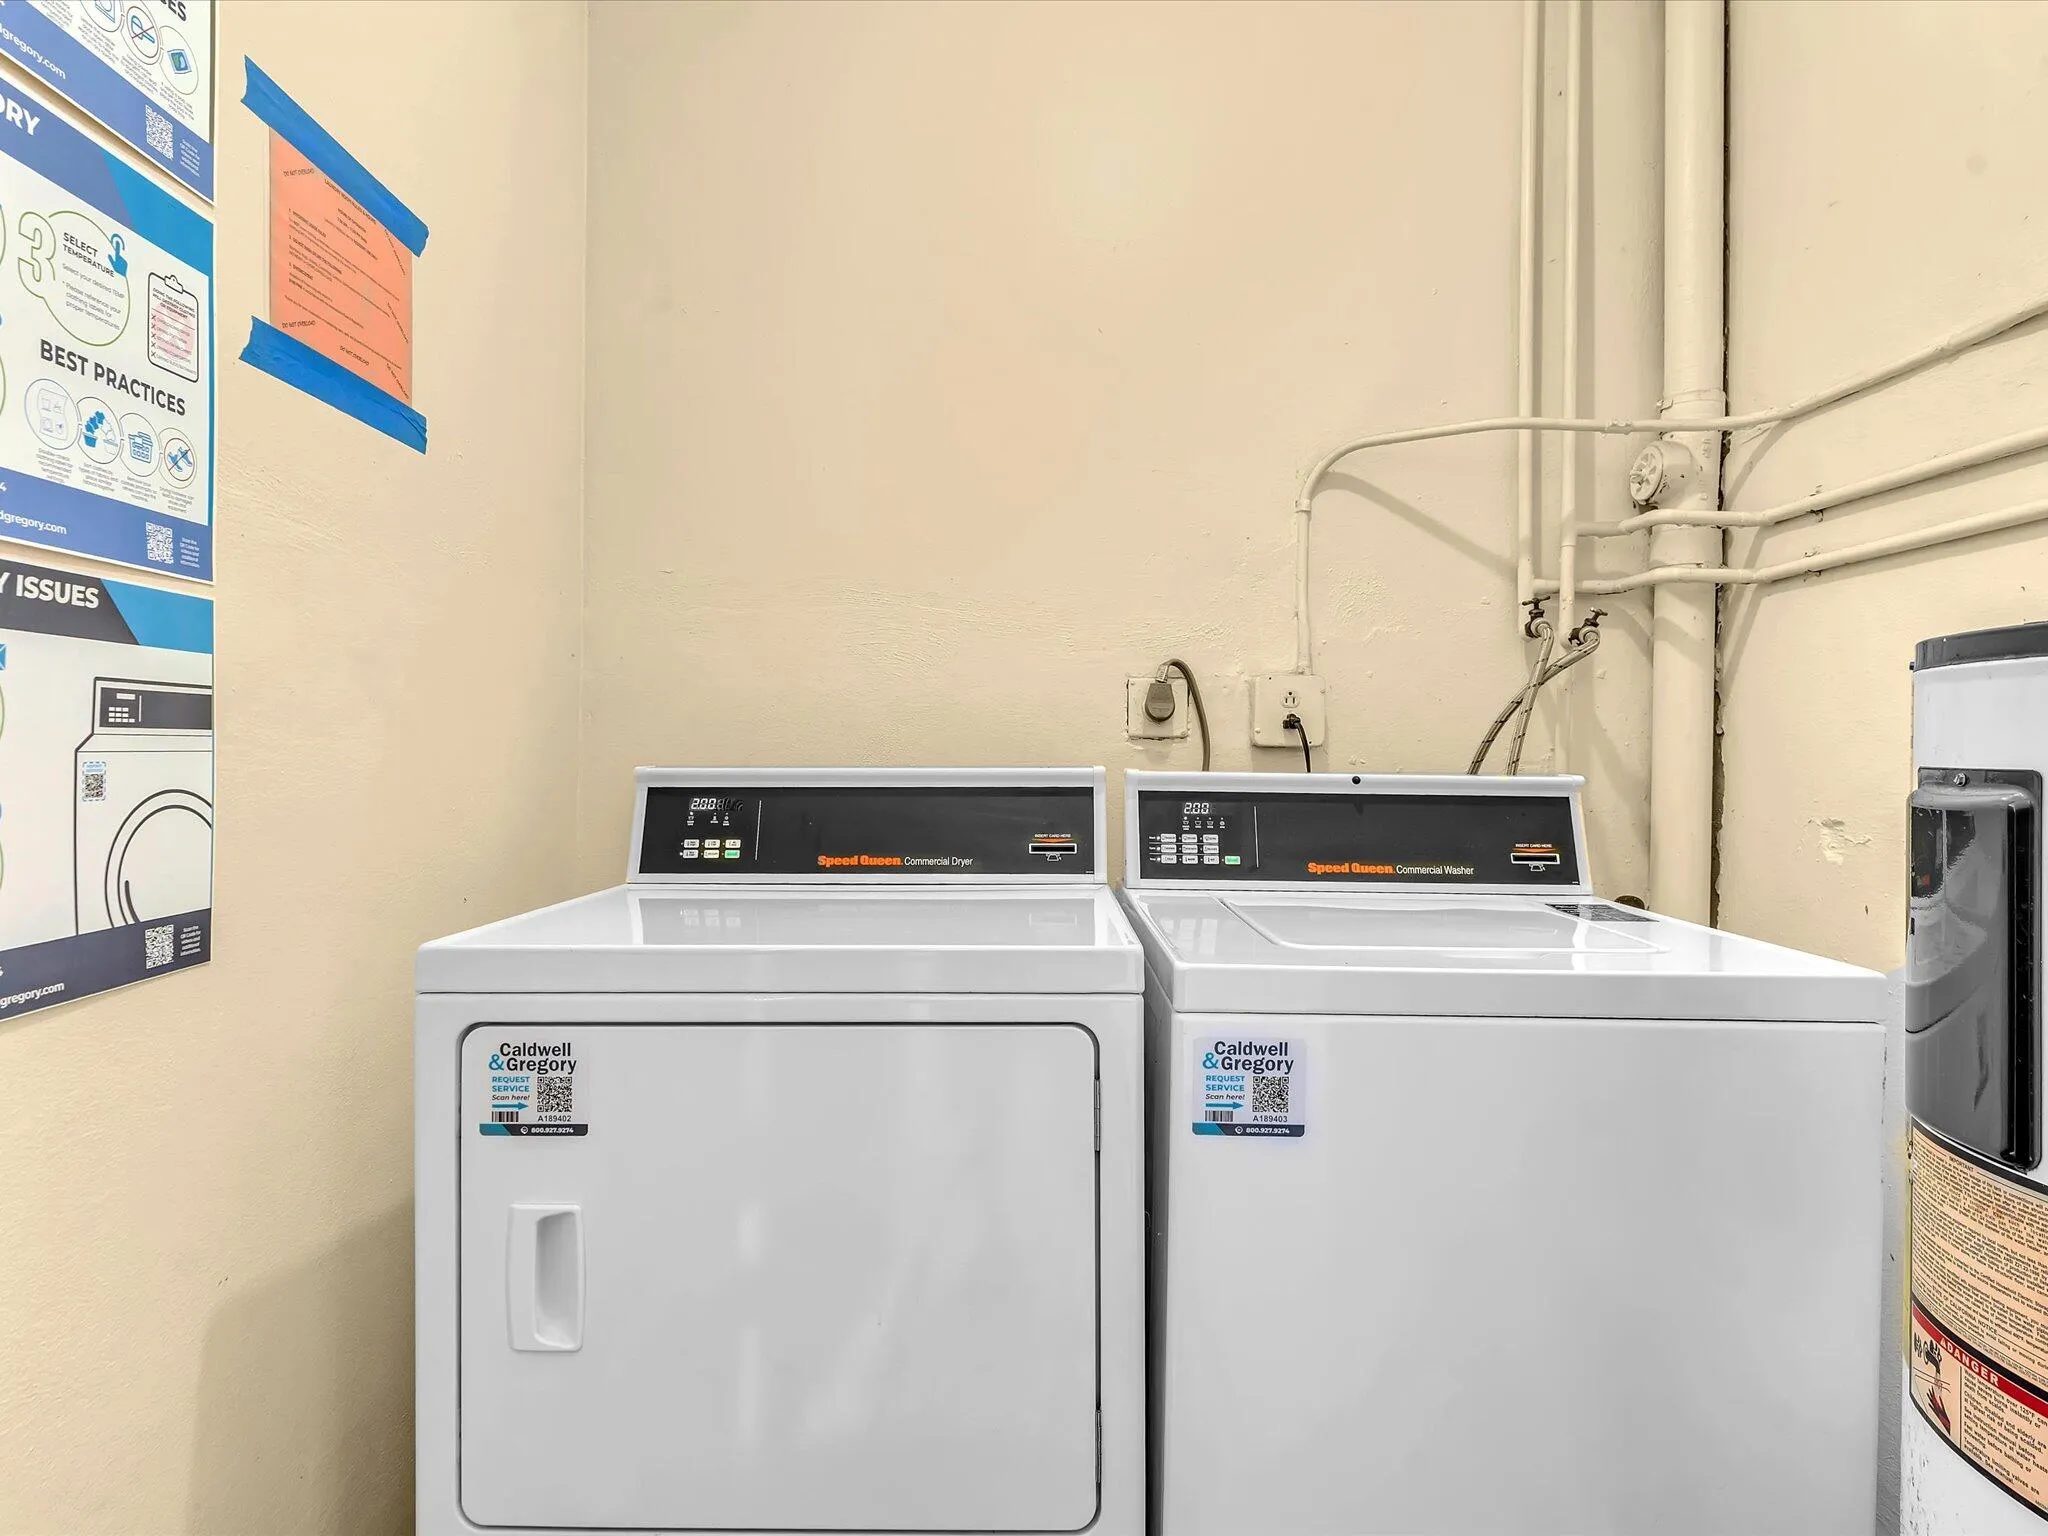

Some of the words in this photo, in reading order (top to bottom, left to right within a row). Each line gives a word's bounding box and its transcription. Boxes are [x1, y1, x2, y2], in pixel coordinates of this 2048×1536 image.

[161, 0, 186, 21] ES
[63, 231, 98, 257] SELECT
[63, 243, 115, 278] TEMPERATURE
[40, 338, 88, 376] BEST
[94, 362, 186, 417] PRACTICES
[16, 574, 99, 609] ISSUES
[1184, 802, 1210, 814] 2.00
[817, 855, 859, 868] Speed
[904, 856, 950, 866] Commercial
[952, 856, 974, 868] Dryer
[1308, 862, 1350, 875] Speed
[1396, 864, 1442, 875] Commercial
[1444, 865, 1474, 876] Washer
[488, 1054, 504, 1071] &
[506, 1058, 577, 1075] Gregory
[500, 1042, 571, 1056] Caldwell
[1202, 1052, 1219, 1069] &
[1221, 1056, 1294, 1075] Gregory
[1214, 1041, 1288, 1056] Caldwell
[1949, 1155, 1973, 1172] IMPORTANT
[1949, 1299, 1976, 1322] CALIFORNIA
[1977, 1319, 1997, 1335] NOTICE
[1947, 1343, 2000, 1387] DANGER
[1964, 1367, 1975, 1380] Water
[1977, 1377, 2004, 1401] temperature
[2006, 1398, 2017, 1408] over
[2037, 1416, 2047, 1426] can
[1964, 1380, 1975, 1393] death
[1976, 1390, 1987, 1401] from
[1988, 1398, 2005, 1414] scalds.
[1964, 1375, 1975, 1387] cause
[1977, 1385, 1992, 1398] severe
[1993, 1395, 2007, 1409] burns
[2009, 1406, 2031, 1425] instantly
[1964, 1412, 1977, 1427] setting
[1979, 1424, 2007, 1448] temperature
[2015, 1448, 2030, 1462] water
[1969, 1400, 1985, 1416] highest
[1986, 1413, 1995, 1422] risk
[2004, 1425, 2017, 1439] being
[2020, 1435, 2042, 1454] scalded.
[1973, 1412, 1996, 1433] instruction
[1998, 1430, 2016, 1447] manual
[2018, 1444, 2035, 1459] before
[1984, 1404, 2003, 1422] disabled
[2006, 1419, 2014, 1430] and
[2017, 1427, 2035, 1443] elderly
[2037, 1440, 2046, 1449] are
[1964, 1436, 1990, 1461] Temperature
[1992, 1458, 2009, 1476] limiting
[2011, 1472, 2028, 1488] valves
[2030, 1485, 2039, 1495] are
[1974, 1428, 1985, 1441] water
[1987, 1438, 2002, 1453] before
[2004, 1450, 2023, 1468] bathing
[1995, 1466, 2014, 1485] manual.
